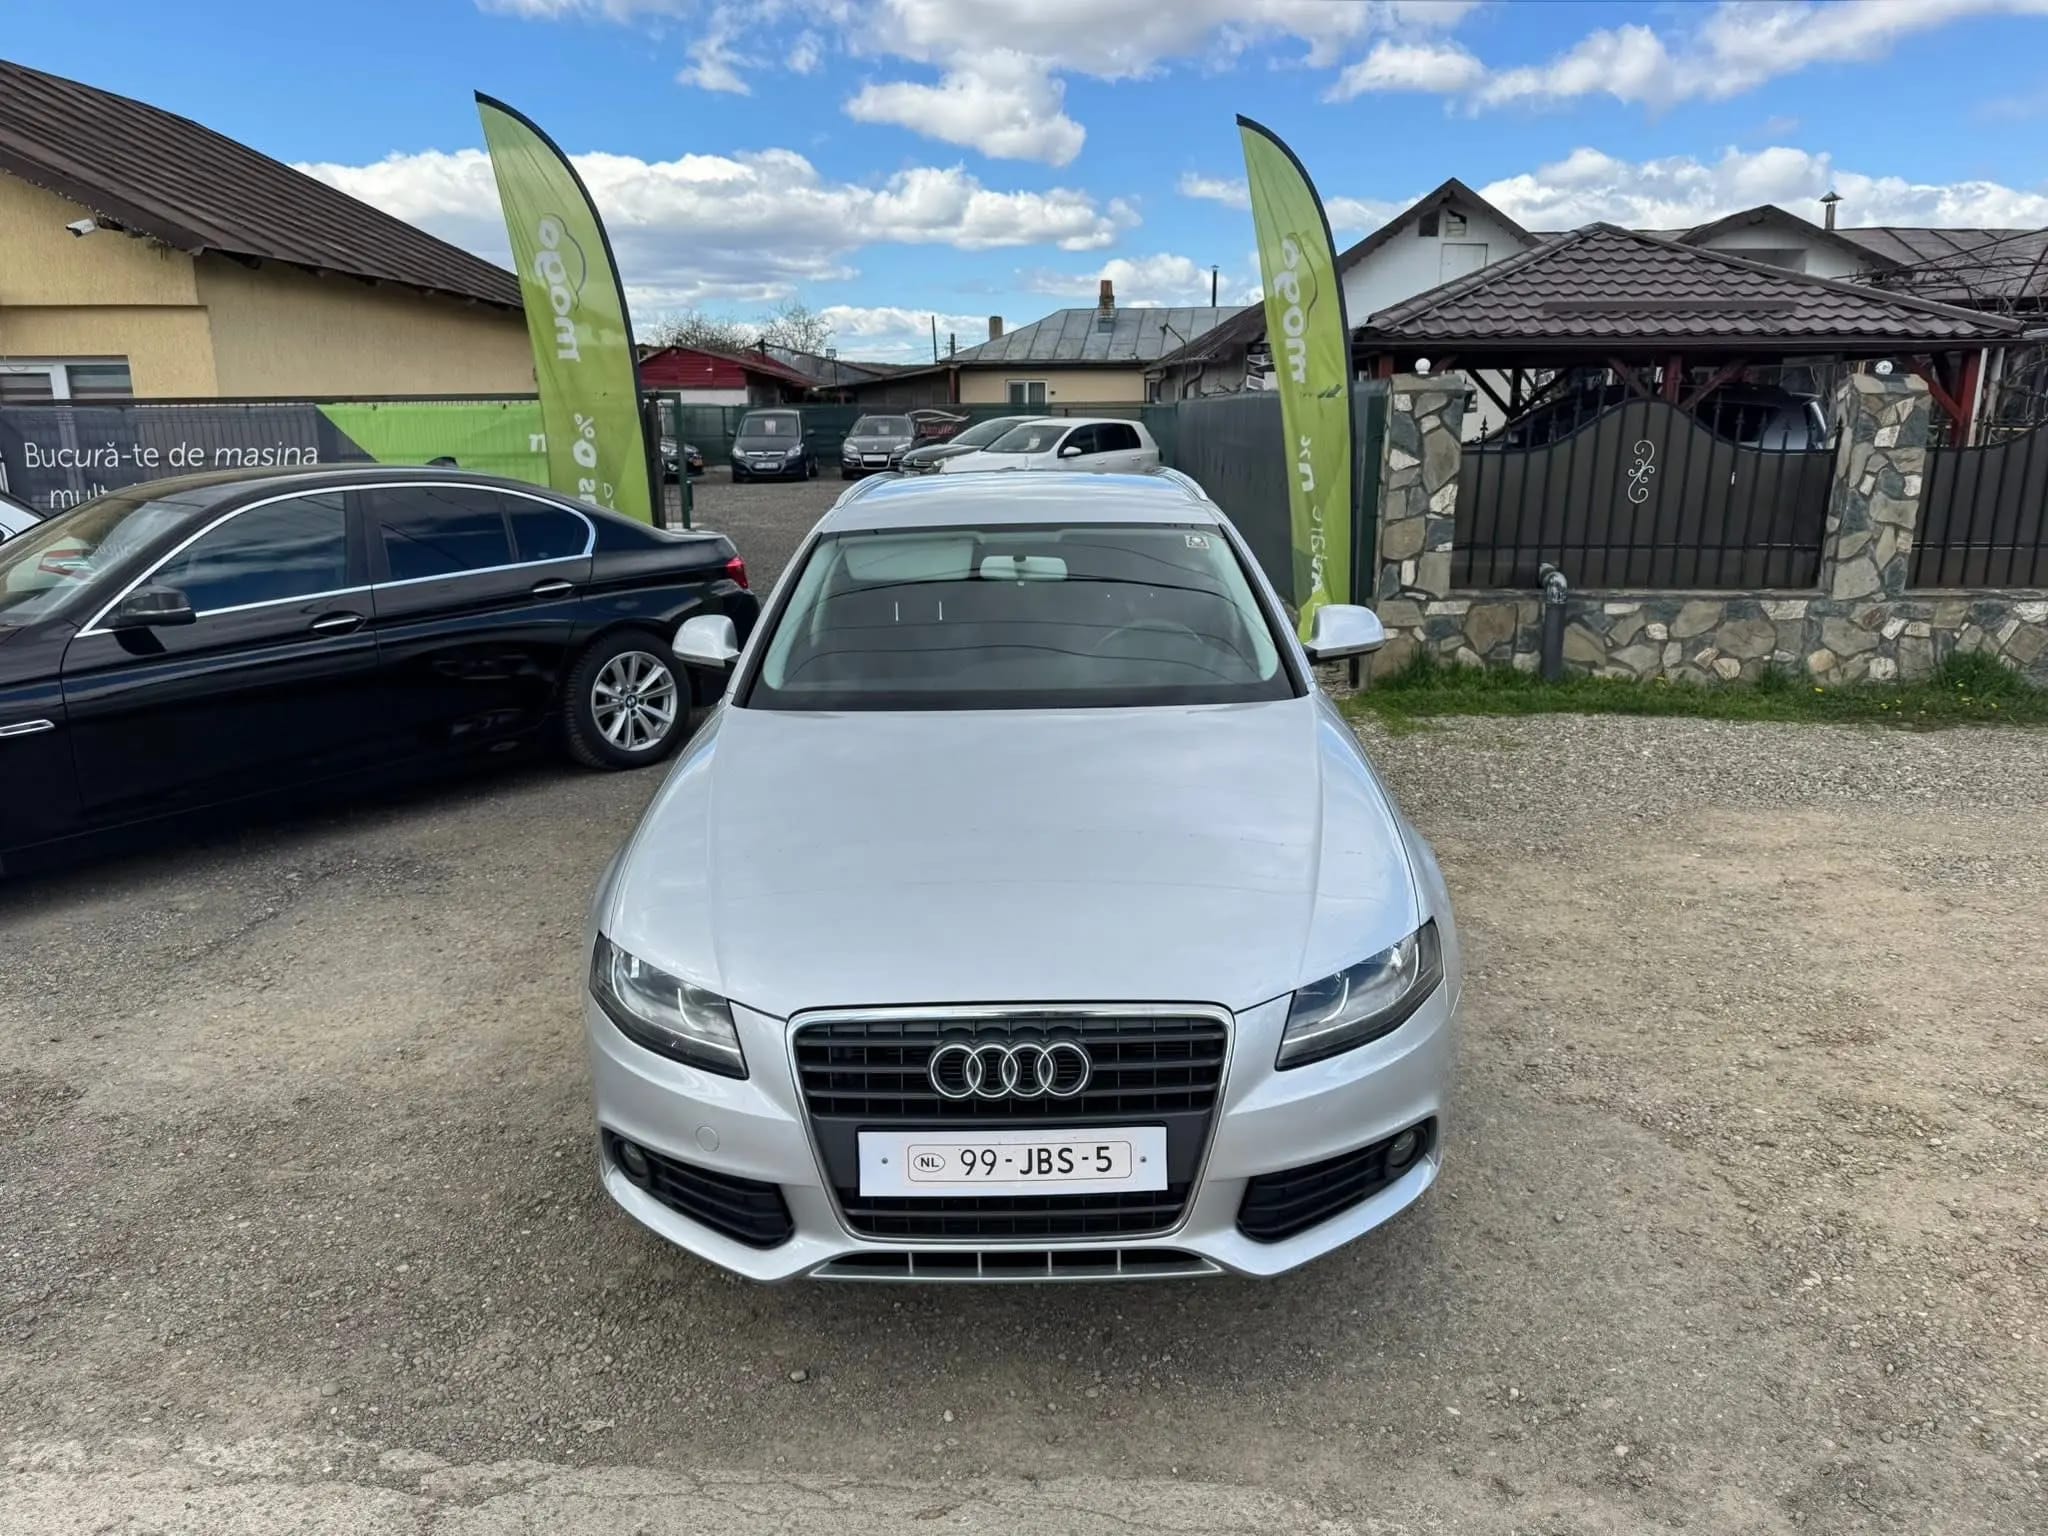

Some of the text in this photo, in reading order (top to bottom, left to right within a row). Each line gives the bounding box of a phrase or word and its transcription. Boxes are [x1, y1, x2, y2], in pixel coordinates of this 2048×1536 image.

[24, 441, 318, 468] Bucură-te de masina
[919, 1157, 940, 1169] NL
